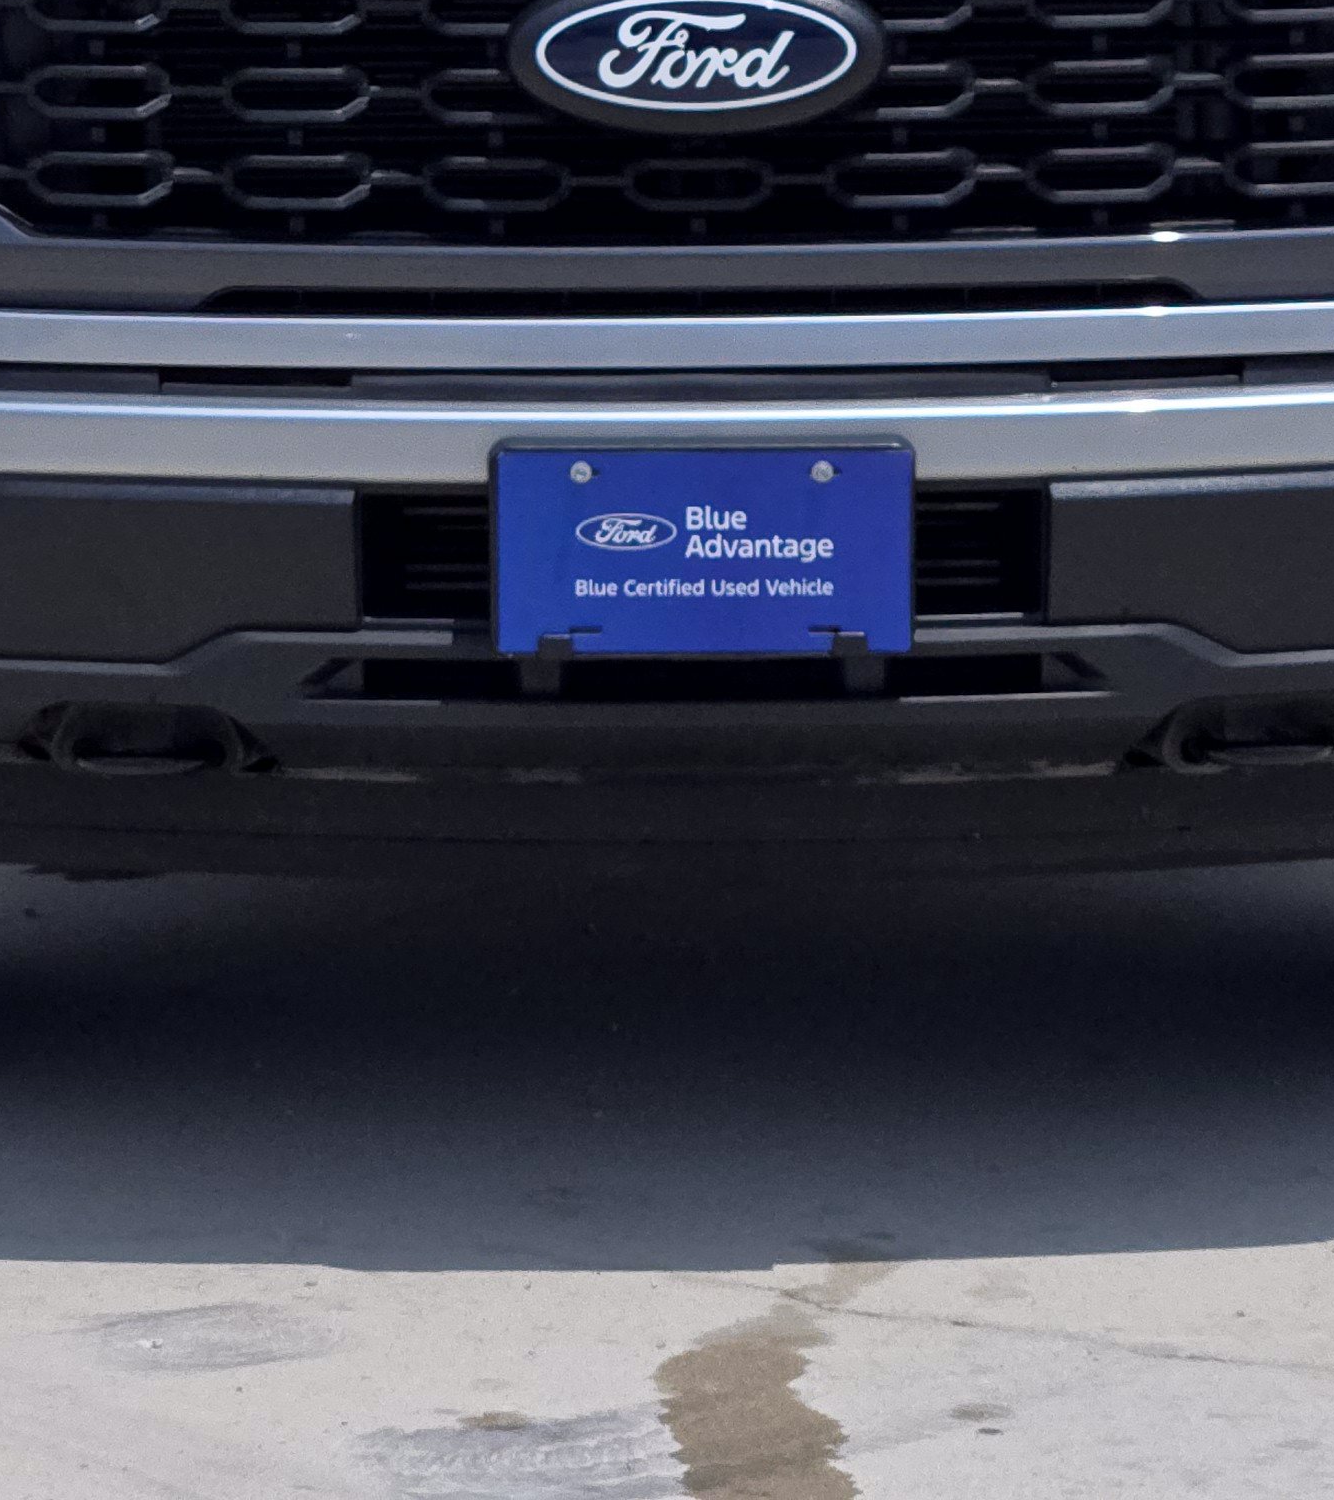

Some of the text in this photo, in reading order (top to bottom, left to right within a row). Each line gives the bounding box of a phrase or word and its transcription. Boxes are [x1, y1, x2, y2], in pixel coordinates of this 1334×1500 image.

[598, 9, 796, 89] Ford
[594, 517, 658, 546] Ford
[685, 505, 748, 532] Blue
[684, 534, 835, 563] Advantage
[574, 578, 834, 598] Blue Certified Used Vehicle
